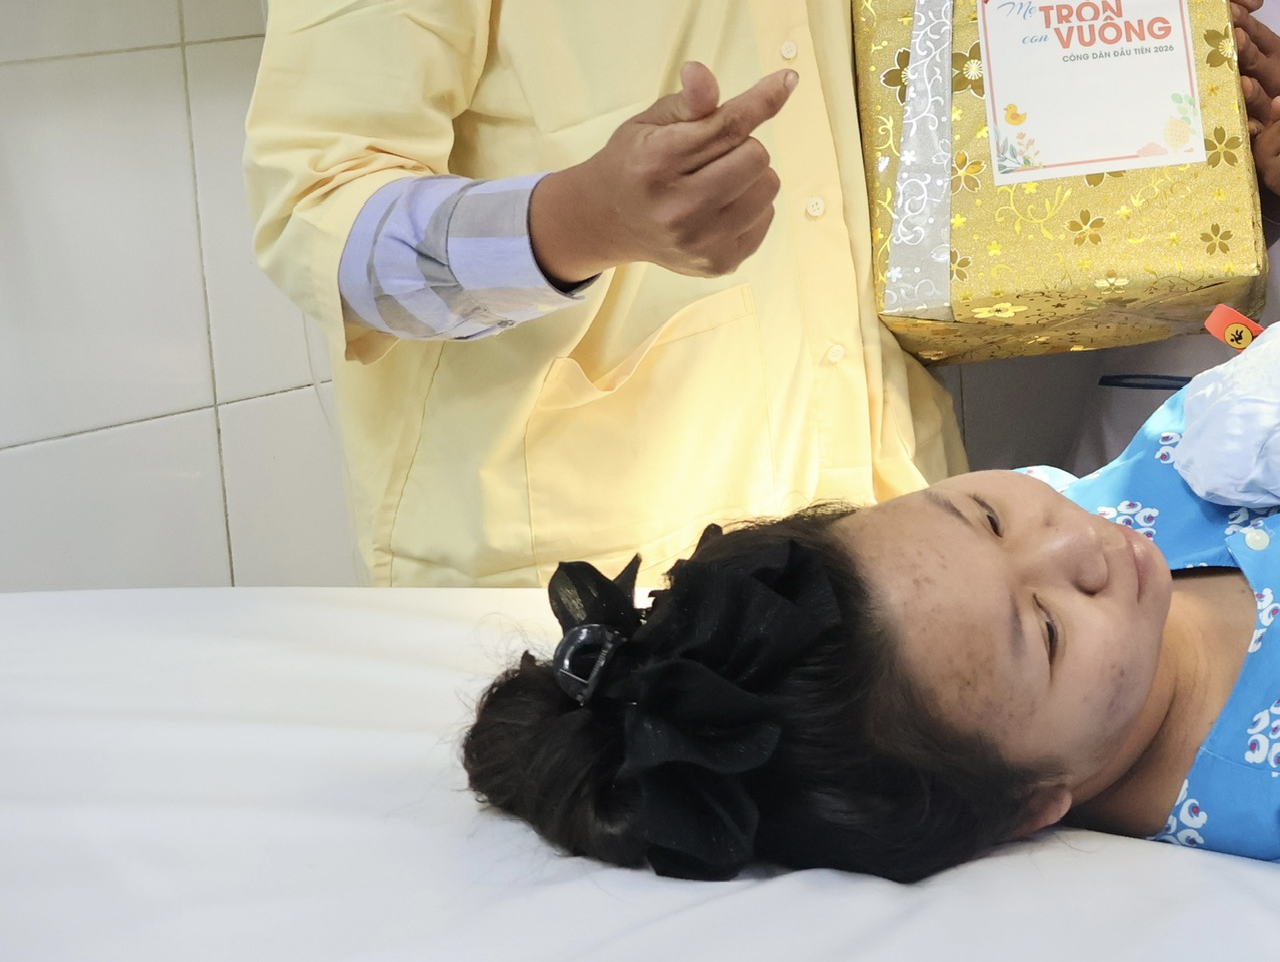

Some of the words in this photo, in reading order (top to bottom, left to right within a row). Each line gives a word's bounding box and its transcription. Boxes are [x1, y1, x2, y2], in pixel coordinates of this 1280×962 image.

[997, 1, 1037, 20] Mẹ
[1022, 34, 1049, 45] con
[1054, 15, 1172, 49] VUÔNG
[1062, 53, 1089, 63] CÔNG
[1092, 51, 1111, 60] DÂN
[1113, 47, 1131, 57] ĐẦU
[1134, 46, 1151, 55] TIÊN
[1154, 45, 1174, 53] 2026
